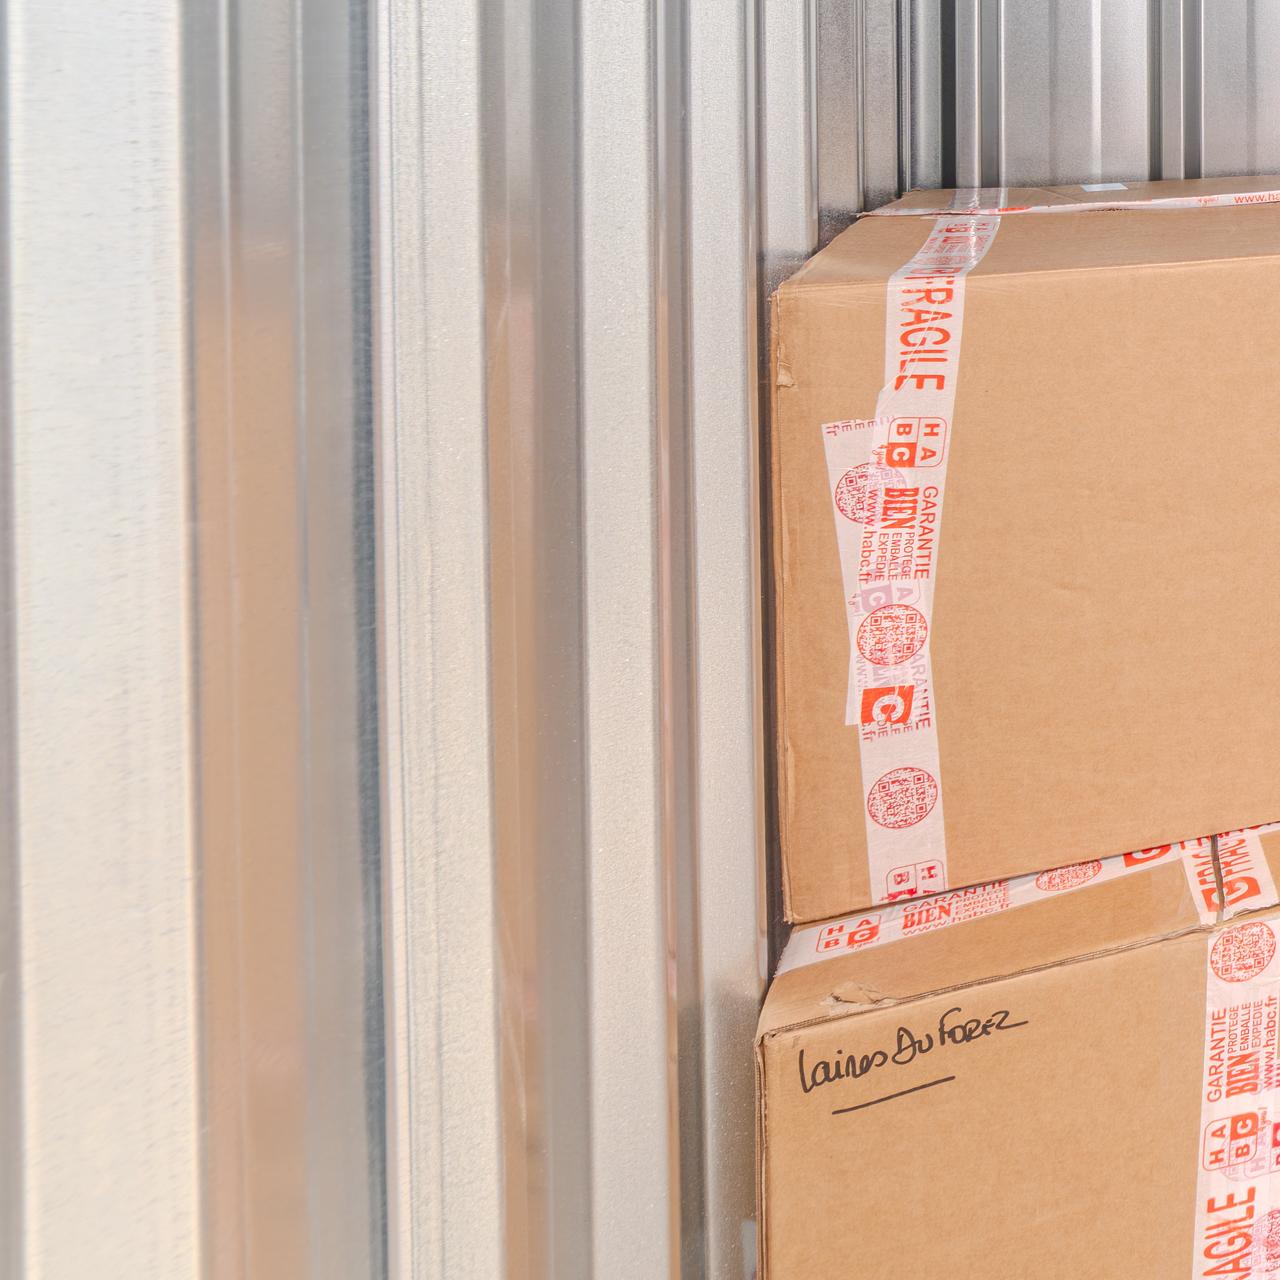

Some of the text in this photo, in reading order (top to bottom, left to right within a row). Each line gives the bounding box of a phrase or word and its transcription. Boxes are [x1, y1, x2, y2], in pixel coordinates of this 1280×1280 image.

[894, 274, 956, 392] FRAGILE
[880, 487, 920, 530] BIEN
[859, 488, 879, 585] www.habc.fr
[875, 533, 889, 581] EXPEDIE
[888, 532, 903, 581] EMBALLE
[901, 532, 915, 580] PROTEGE
[914, 486, 939, 580] GARANTIE
[901, 903, 953, 931] BIEN
[902, 880, 1009, 914] GARANTIE
[902, 902, 1012, 937] www.habc.fr
[955, 892, 1009, 911] EMBALLE
[955, 898, 1009, 917] EXPEDIE
[1228, 1005, 1239, 1053] PROTEGE
[1240, 1001, 1251, 1051] EMBALLE
[1252, 1000, 1263, 1048] EXPEDIE
[1263, 995, 1278, 1089] www.habc.fr
[1207, 1008, 1227, 1102] GARANTIE
[1225, 1051, 1260, 1099] BIEN
